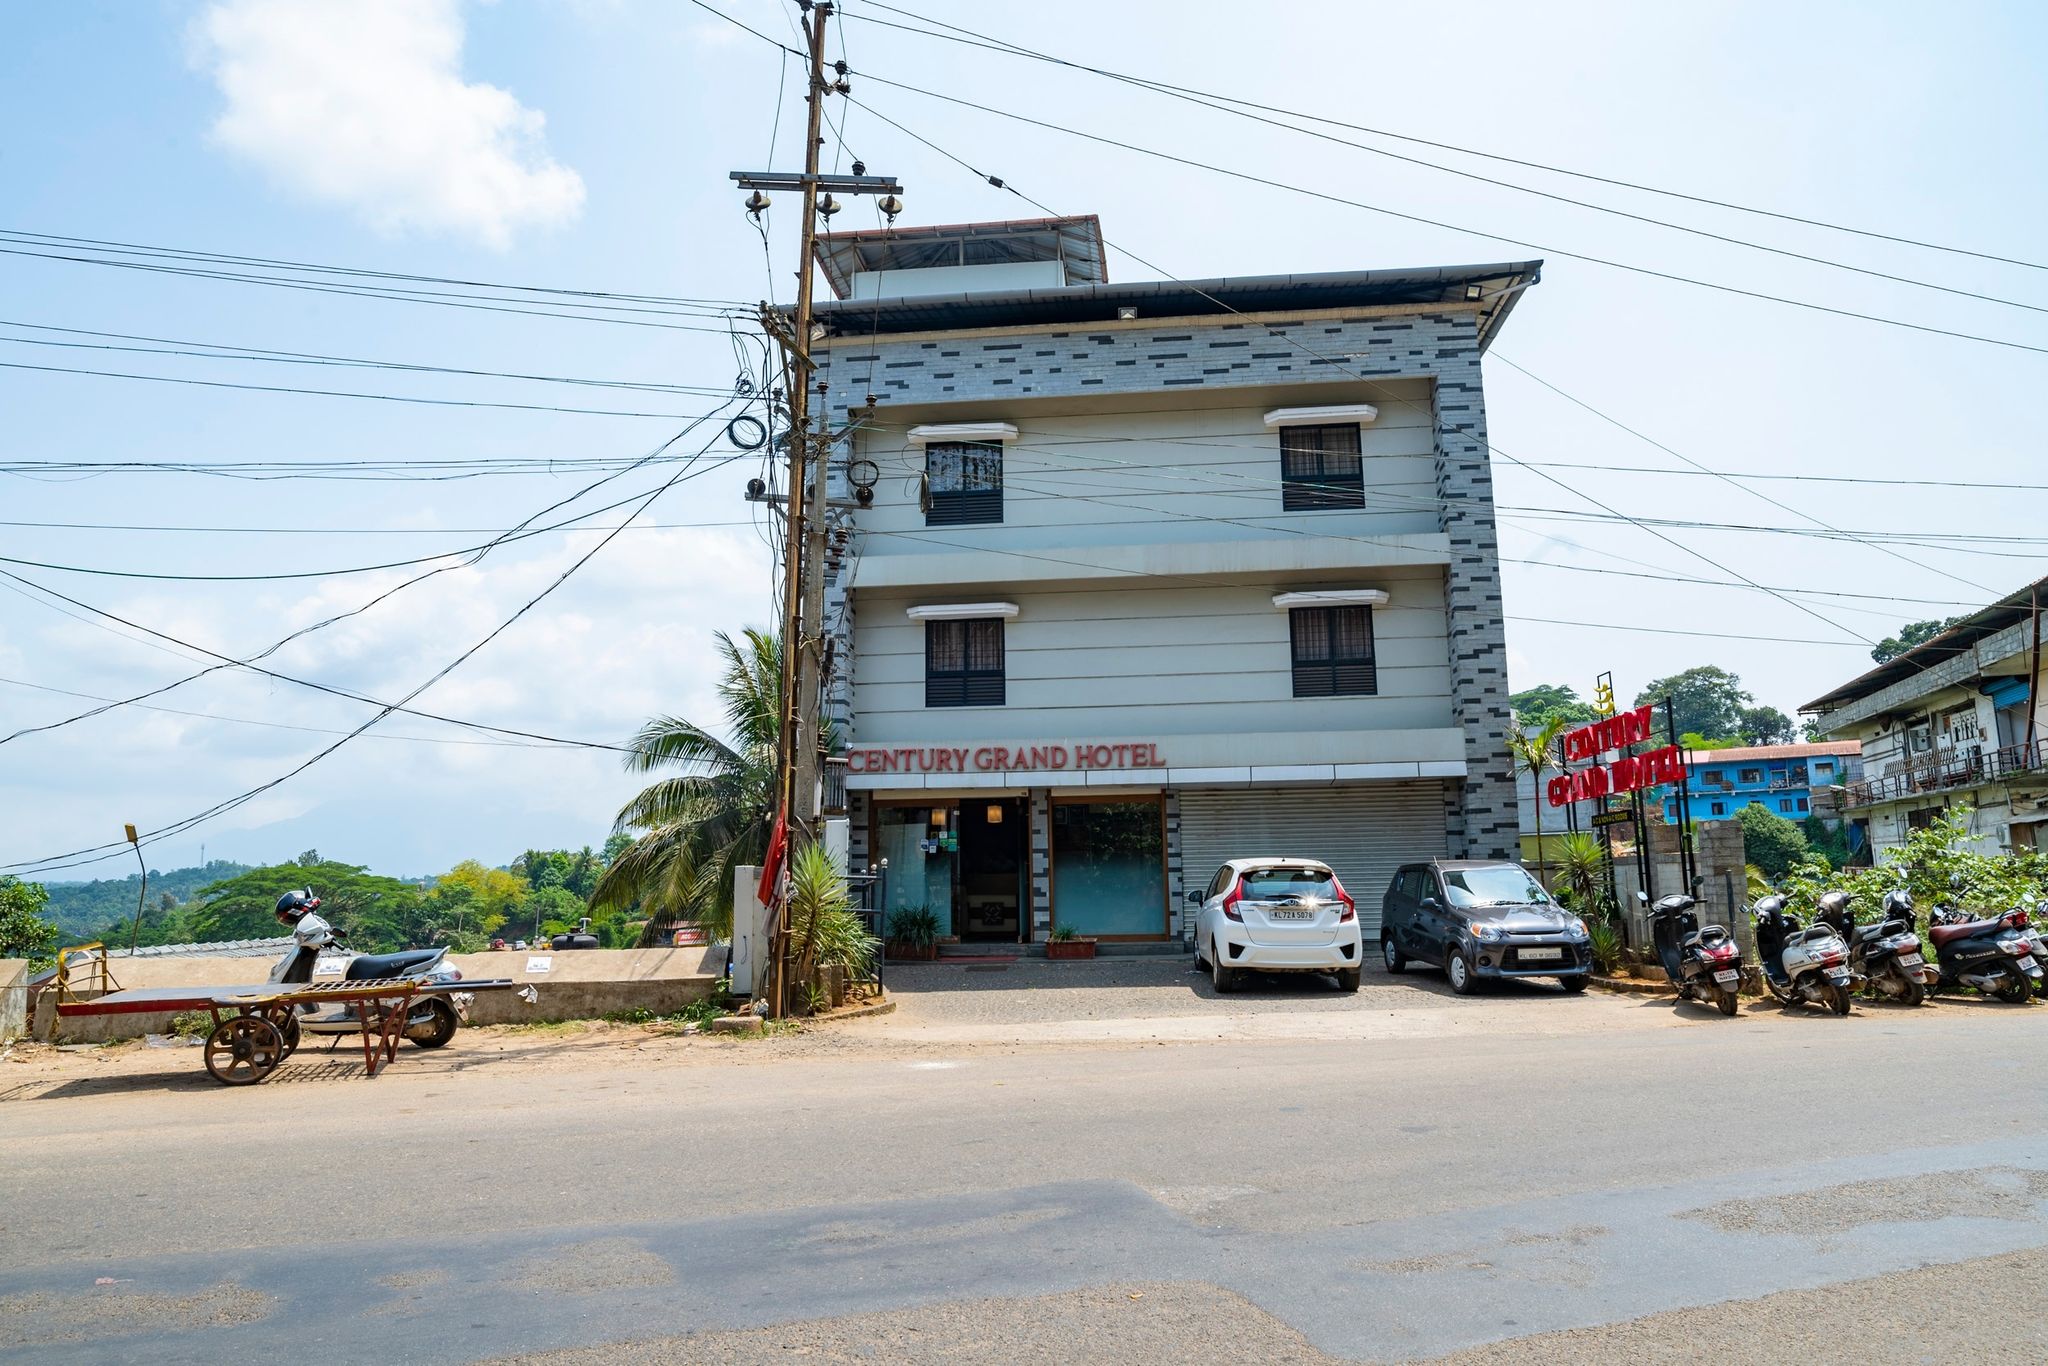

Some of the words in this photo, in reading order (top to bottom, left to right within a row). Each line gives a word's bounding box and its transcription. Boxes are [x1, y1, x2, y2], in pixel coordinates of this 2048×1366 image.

[847, 748, 969, 773] CENTURY
[974, 746, 1068, 770] GRAND
[1075, 743, 1166, 768] HOTEL
